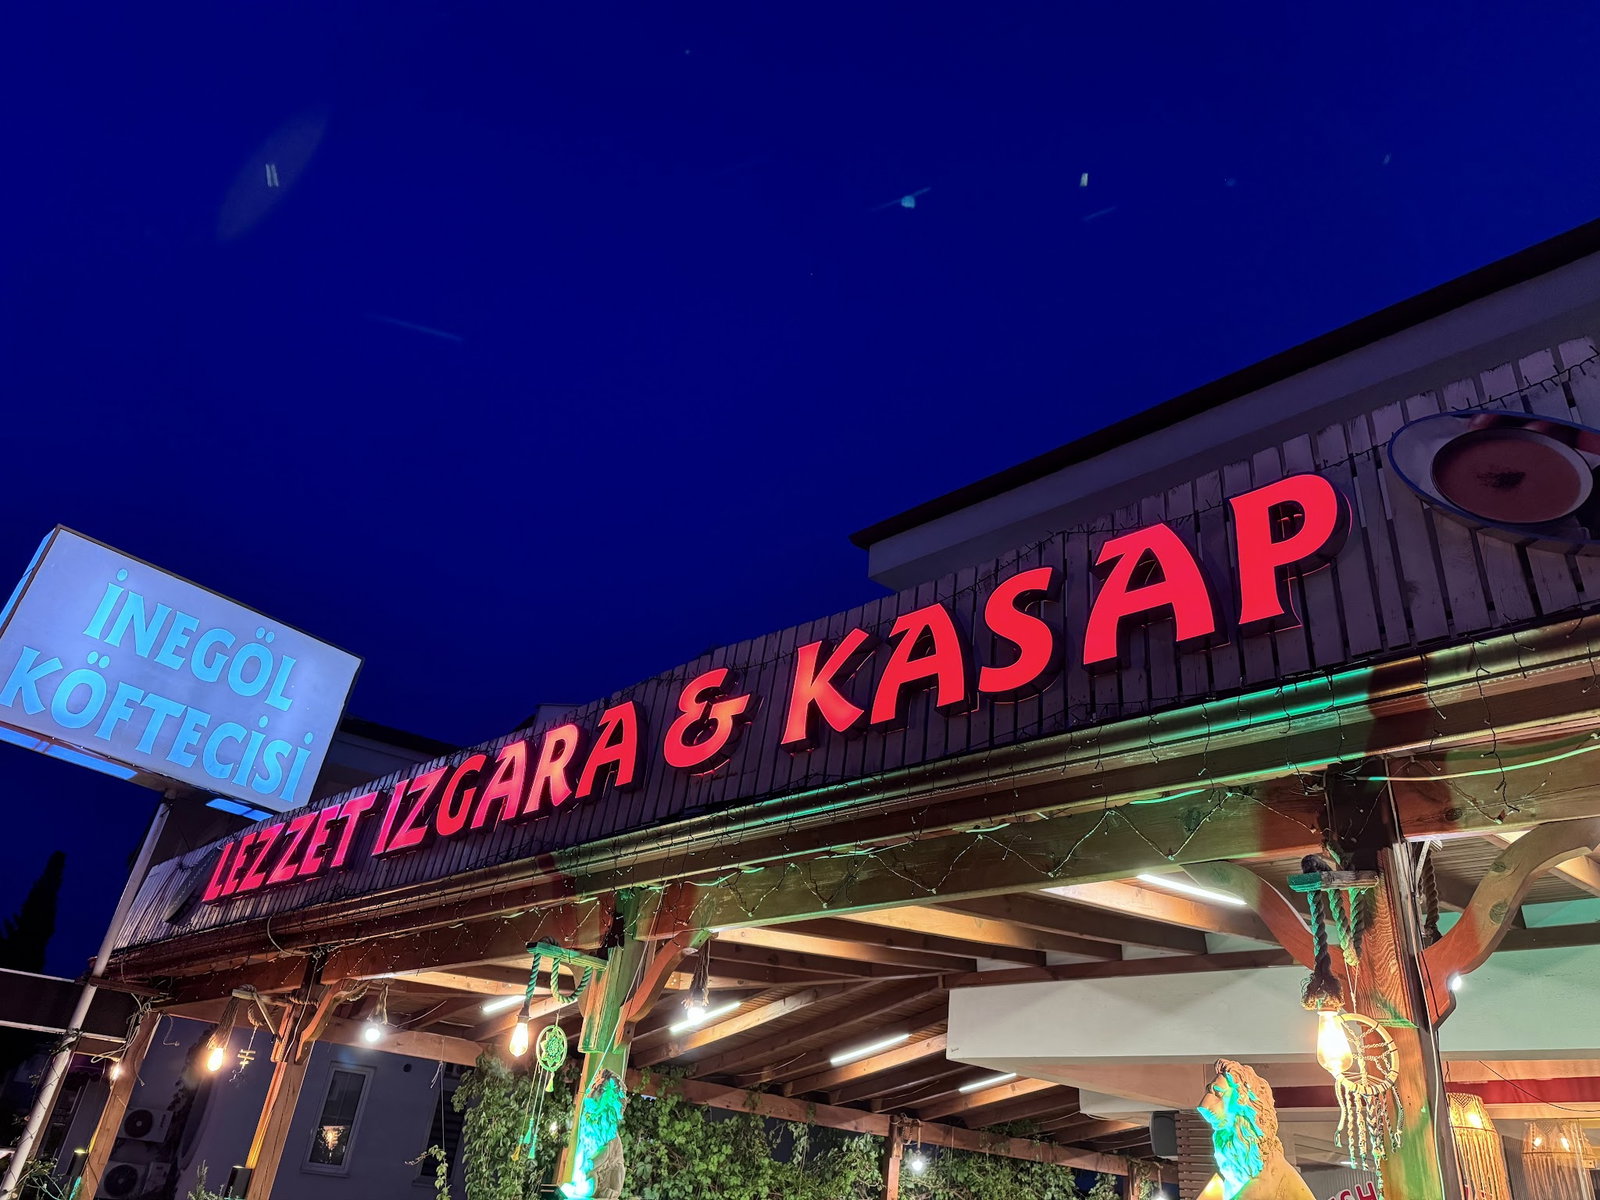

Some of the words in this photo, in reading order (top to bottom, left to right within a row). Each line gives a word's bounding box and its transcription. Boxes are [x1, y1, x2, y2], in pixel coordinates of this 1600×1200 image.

[83, 568, 296, 711] İNEGÖL
[203, 792, 376, 902] LEZZET
[372, 700, 637, 857] IZGARA
[664, 668, 750, 768] &
[781, 473, 1338, 745] KASAP
[0, 646, 313, 802] KÖFTECİSİ
